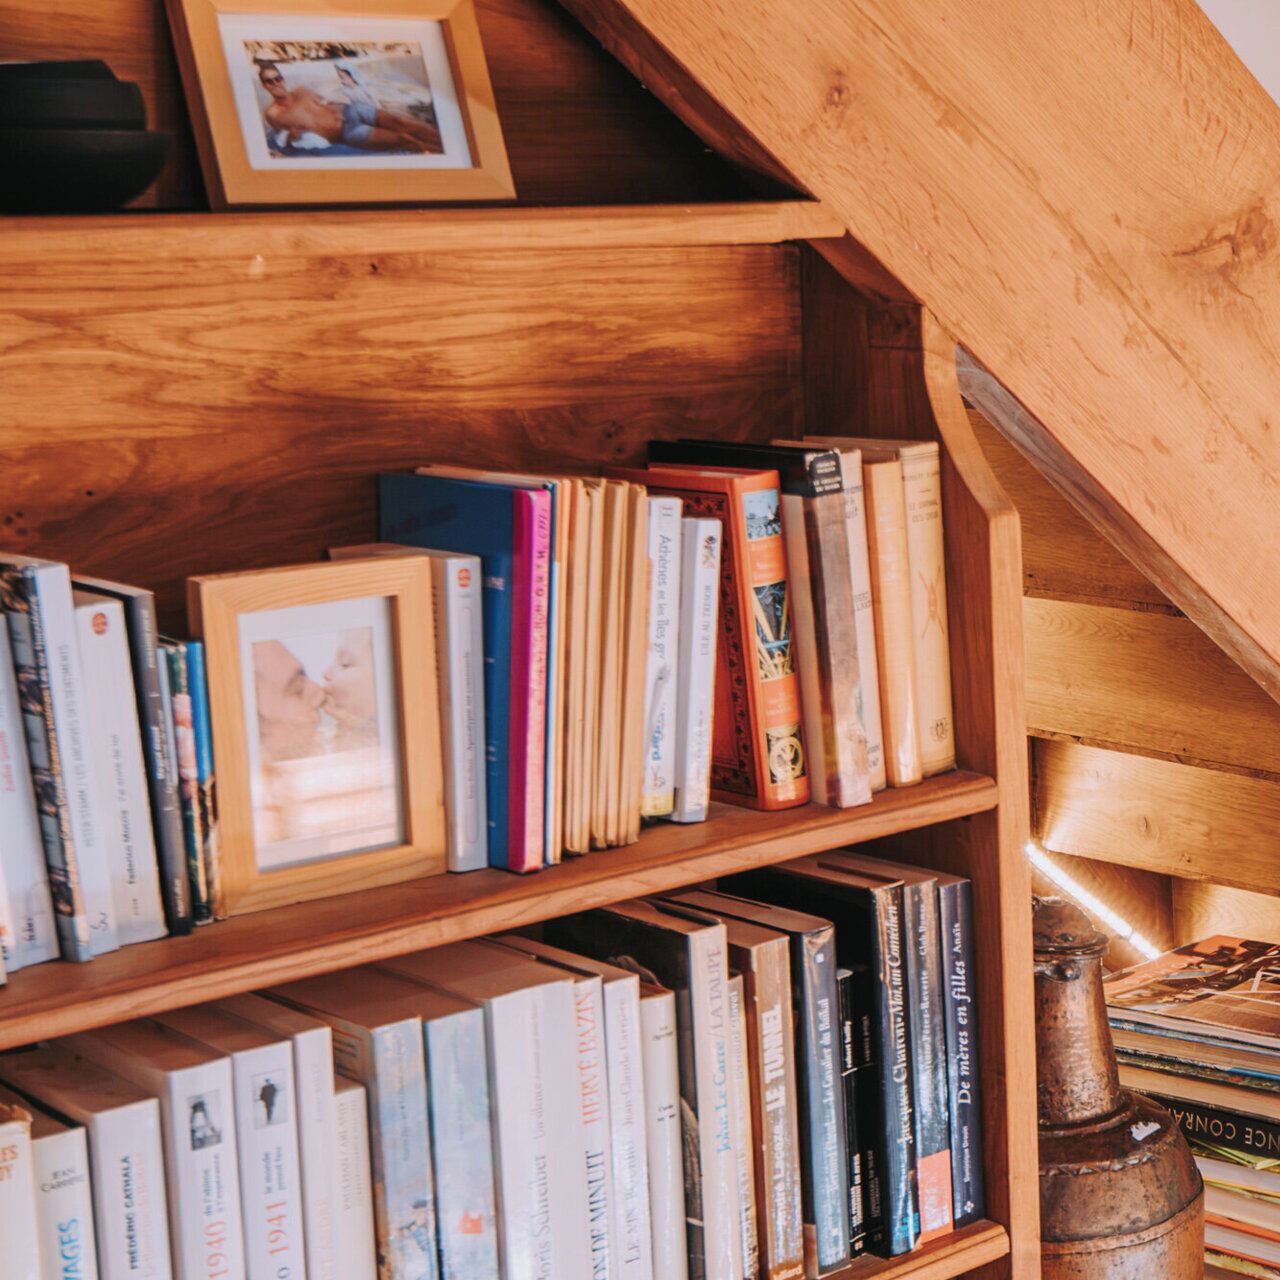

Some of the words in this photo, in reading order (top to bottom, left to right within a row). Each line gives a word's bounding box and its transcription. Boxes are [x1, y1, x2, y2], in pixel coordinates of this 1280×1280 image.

[655, 602, 667, 616] les
[656, 589, 666, 600] et
[79, 788, 91, 819] STAMM
[949, 922, 962, 954] Anaïs
[705, 943, 724, 1005] TAUPE
[948, 959, 970, 1004] filles
[573, 988, 597, 1053] BAZIN
[708, 1006, 724, 1029] LA
[955, 1004, 967, 1025] en
[757, 1003, 787, 1084] TUNNEL
[819, 1031, 831, 1045] du
[952, 1029, 971, 1076] mères
[575, 1059, 602, 1126] HERVÉ
[763, 1084, 788, 1111] LE
[956, 1080, 972, 1104] De
[1166, 1107, 1236, 1140] CONRA
[119, 1154, 134, 1209] CATHALA
[525, 1152, 552, 1237] Schreiber
[583, 1148, 609, 1225] MINUIT
[123, 1212, 139, 1270] FRÉDÉRIC
[202, 1219, 230, 1280] 1940
[263, 1199, 292, 1257] 1941
[588, 1227, 610, 1252] DE
